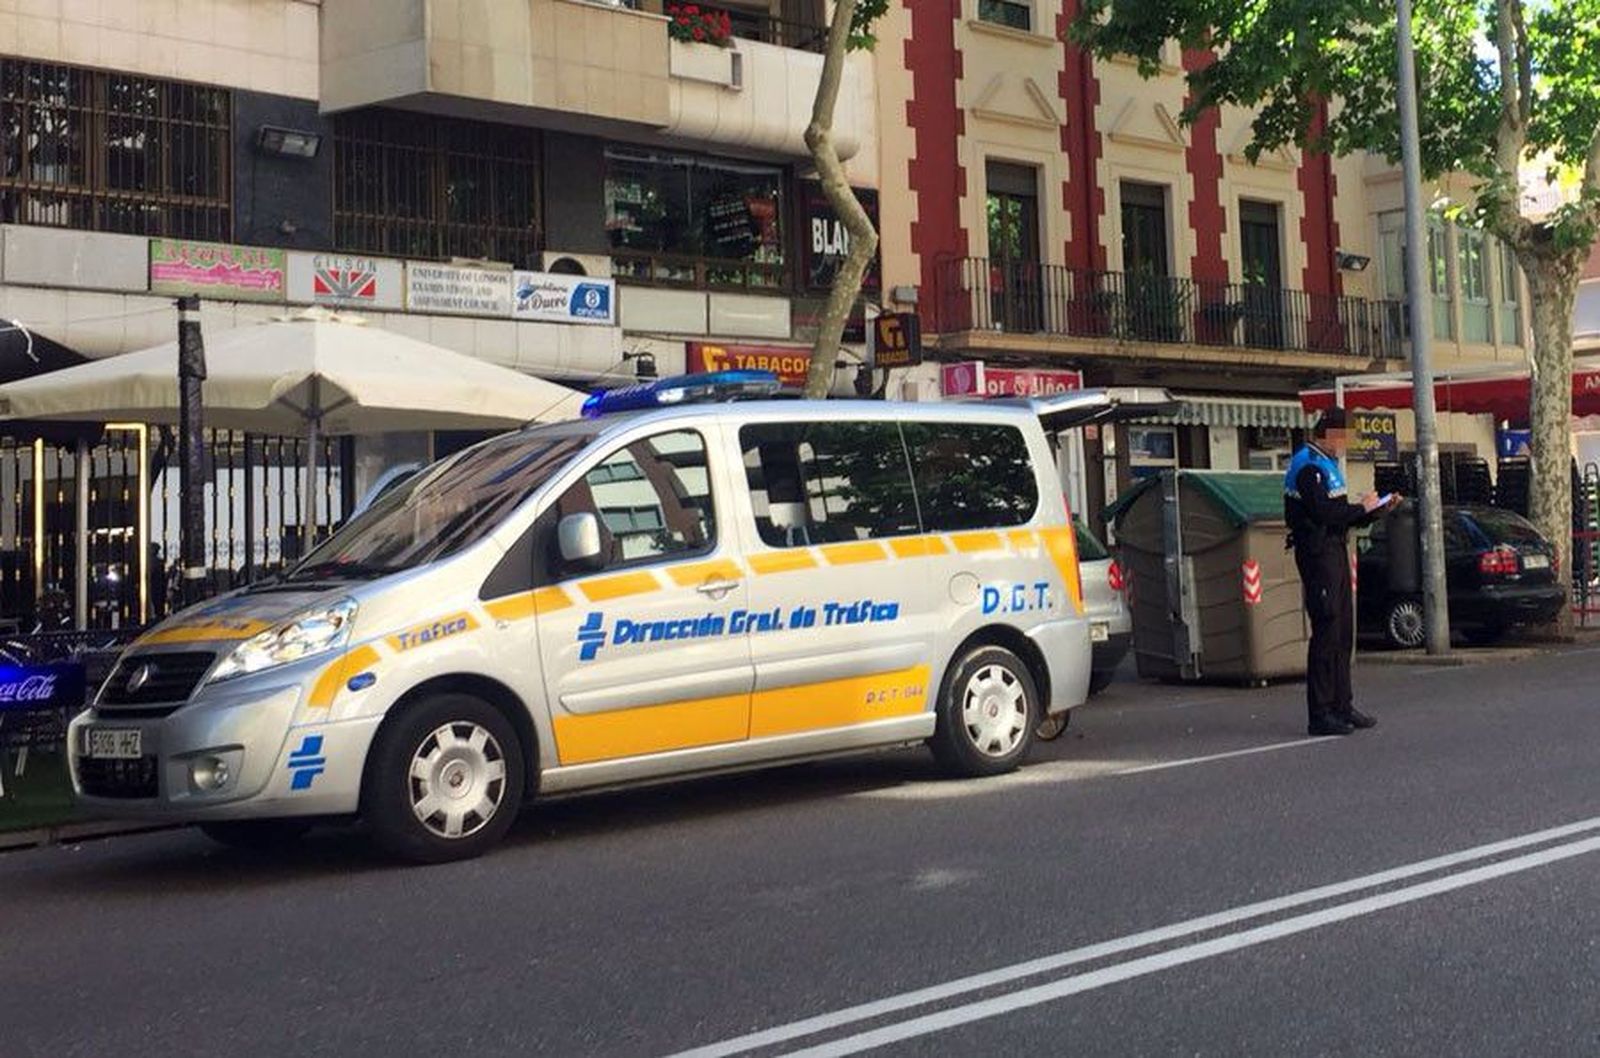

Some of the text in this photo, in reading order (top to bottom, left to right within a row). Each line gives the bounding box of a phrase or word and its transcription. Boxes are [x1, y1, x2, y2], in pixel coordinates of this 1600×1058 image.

[313, 255, 377, 273] GILSON
[412, 266, 460, 281] UNIVERSITY
[474, 271, 508, 285] LONDON
[464, 298, 499, 311] COUNCIL
[531, 294, 568, 311] Duero
[588, 291, 598, 309] 8
[613, 600, 899, 645] Dirección Gral. de Tráfico
